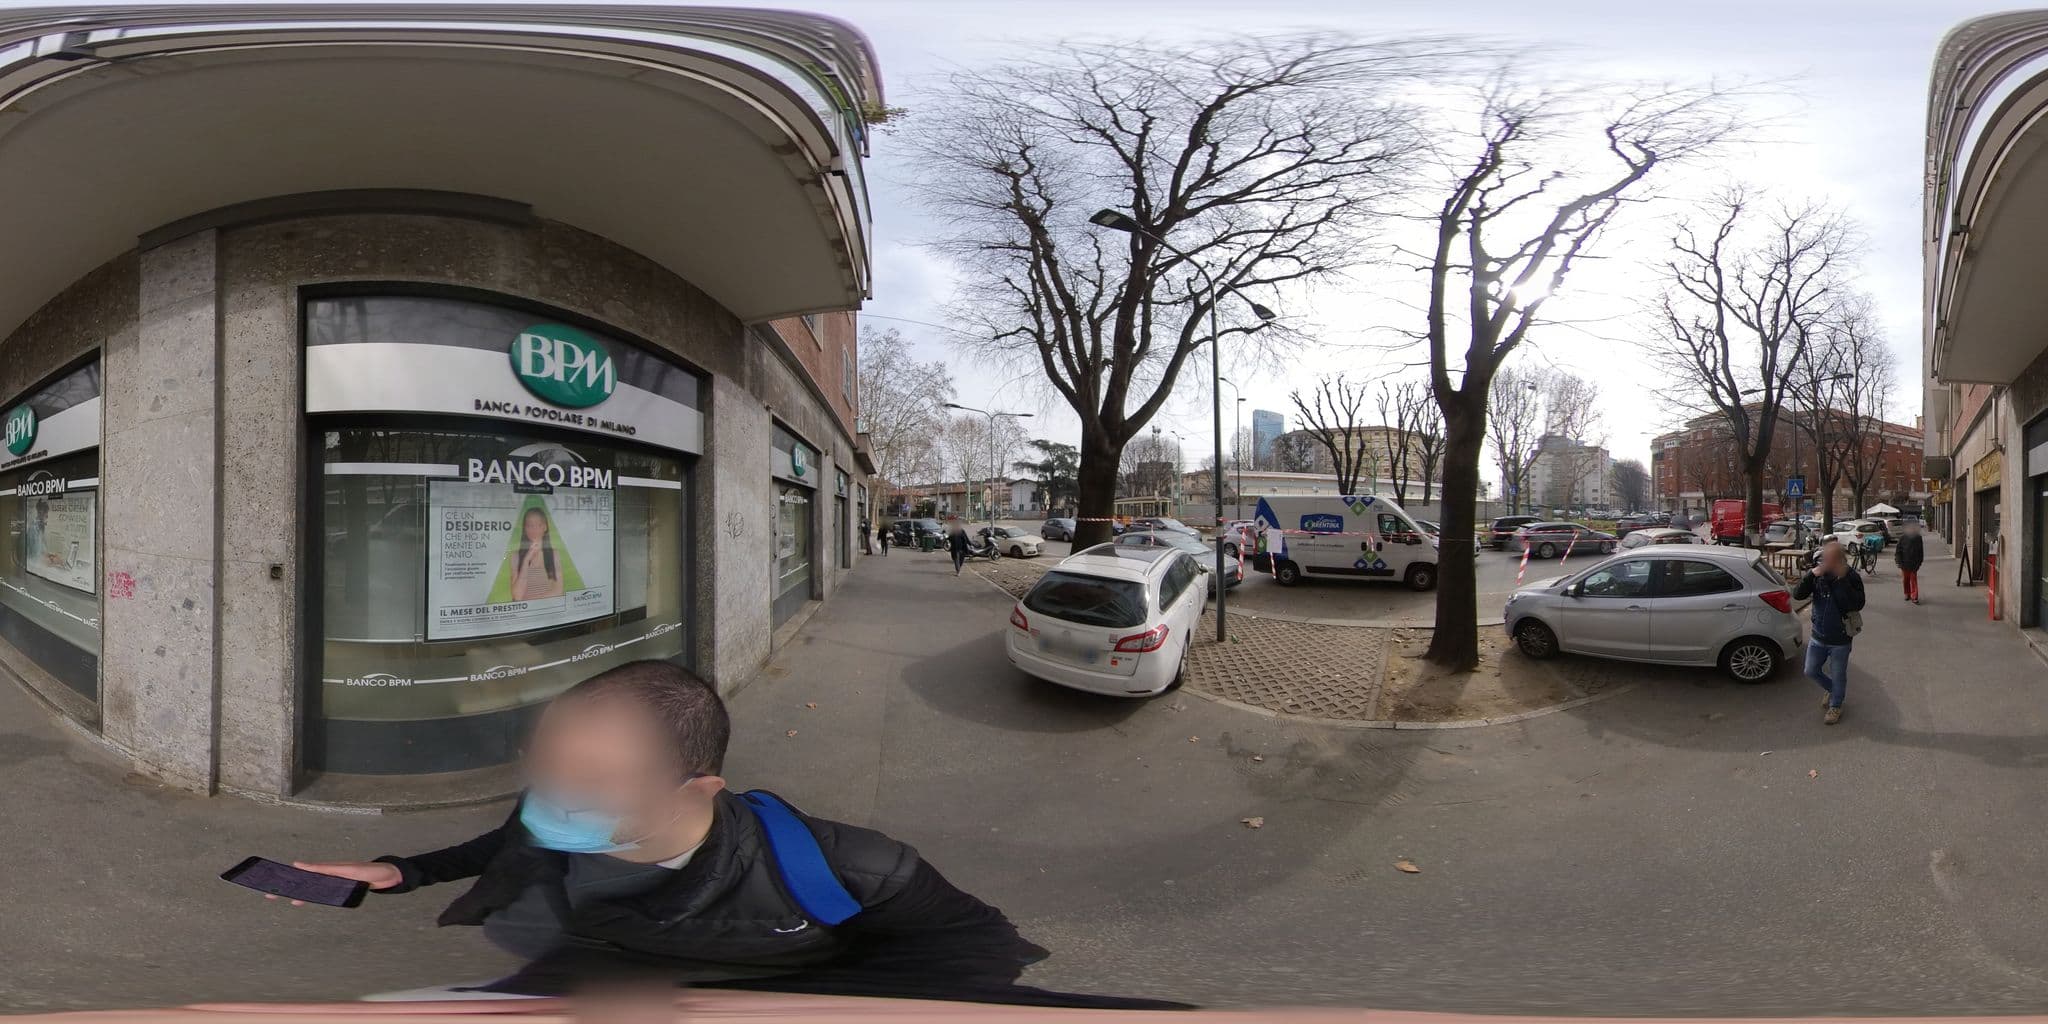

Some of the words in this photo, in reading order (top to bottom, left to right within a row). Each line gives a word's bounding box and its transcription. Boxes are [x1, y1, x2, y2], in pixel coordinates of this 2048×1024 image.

[520, 333, 612, 394] BPM
[474, 399, 520, 415] BANCA
[525, 406, 583, 425] POPOLARE
[587, 417, 597, 427] DI
[600, 420, 636, 435] MILANO
[5, 409, 33, 447] BPM
[468, 457, 565, 487] BANCO
[570, 465, 612, 490] BPM
[18, 481, 44, 497] BANCO
[45, 477, 65, 494] BPM
[460, 511, 475, 520] UN
[445, 520, 512, 532] DESIDERIO
[444, 532, 461, 541] CHE
[464, 532, 479, 541] HO
[480, 533, 490, 541] IN
[444, 541, 473, 550] MENTE
[475, 541, 487, 550] DA
[444, 550, 473, 559] TANTO
[440, 609, 448, 617] IL
[450, 607, 473, 616] MESE
[475, 606, 490, 614] DEL
[492, 602, 529, 613] PRESTITO
[645, 628, 665, 640] BANCO
[571, 649, 599, 662] BANCO
[599, 644, 614, 655] BPM
[470, 670, 507, 682] BANCO
[507, 666, 527, 676] BPM
[346, 678, 387, 687] BANCO
[388, 678, 412, 687] BPM
